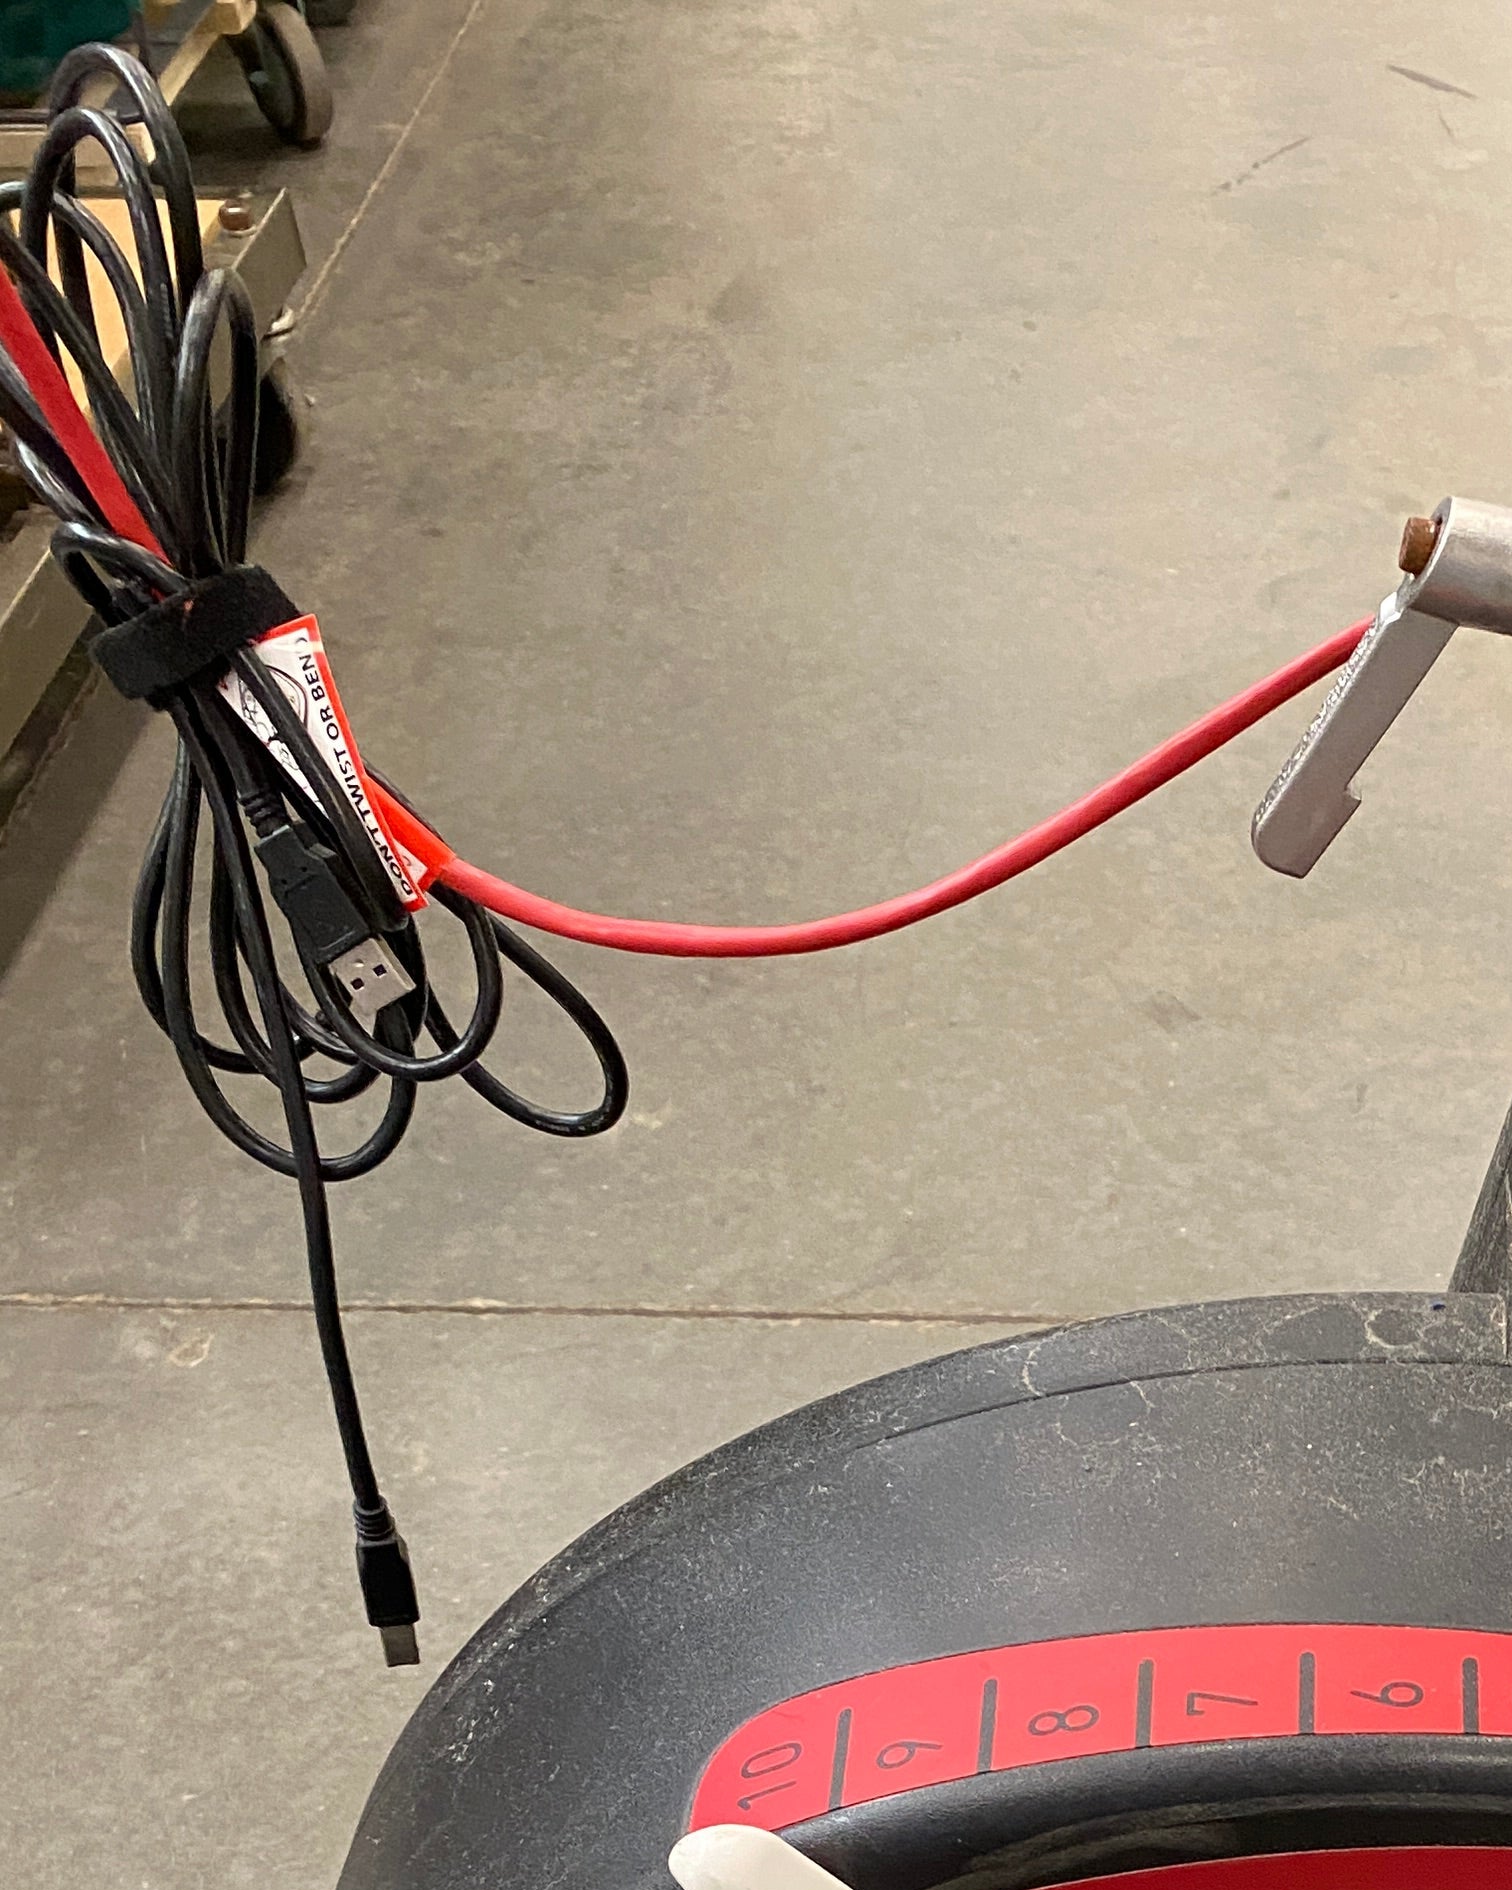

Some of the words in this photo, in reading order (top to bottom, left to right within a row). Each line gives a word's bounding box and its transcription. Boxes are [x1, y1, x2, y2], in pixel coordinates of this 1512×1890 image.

[319, 704, 340, 741] OR
[333, 747, 371, 822] TWIST
[366, 825, 414, 896] DON'T
[1186, 1691, 1259, 1717] 7
[1350, 1680, 1424, 1708] 6
[1027, 1704, 1101, 1736] 8
[875, 1740, 944, 1770] 9
[737, 1741, 803, 1811] 10
